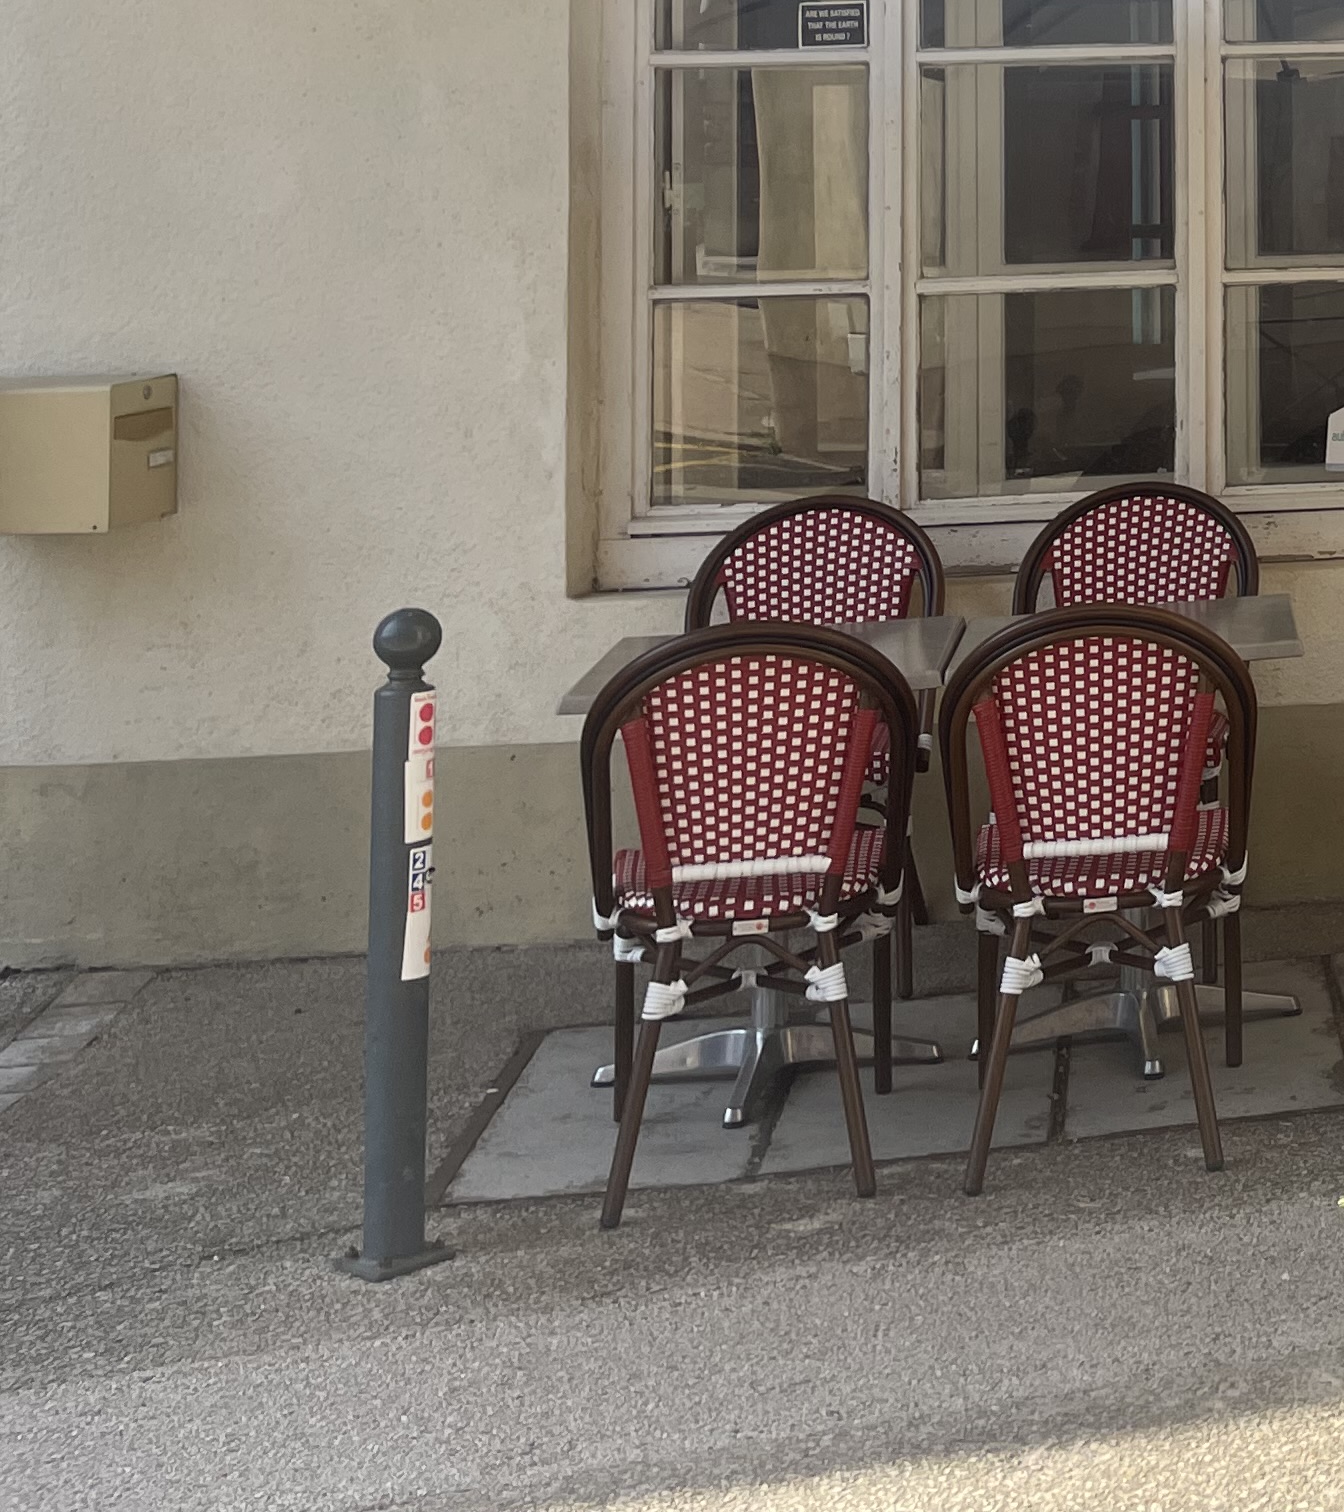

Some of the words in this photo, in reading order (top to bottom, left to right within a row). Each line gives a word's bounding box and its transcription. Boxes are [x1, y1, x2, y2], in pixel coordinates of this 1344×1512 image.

[414, 852, 424, 869] 2
[413, 873, 423, 889] 4
[413, 894, 423, 911] 5
